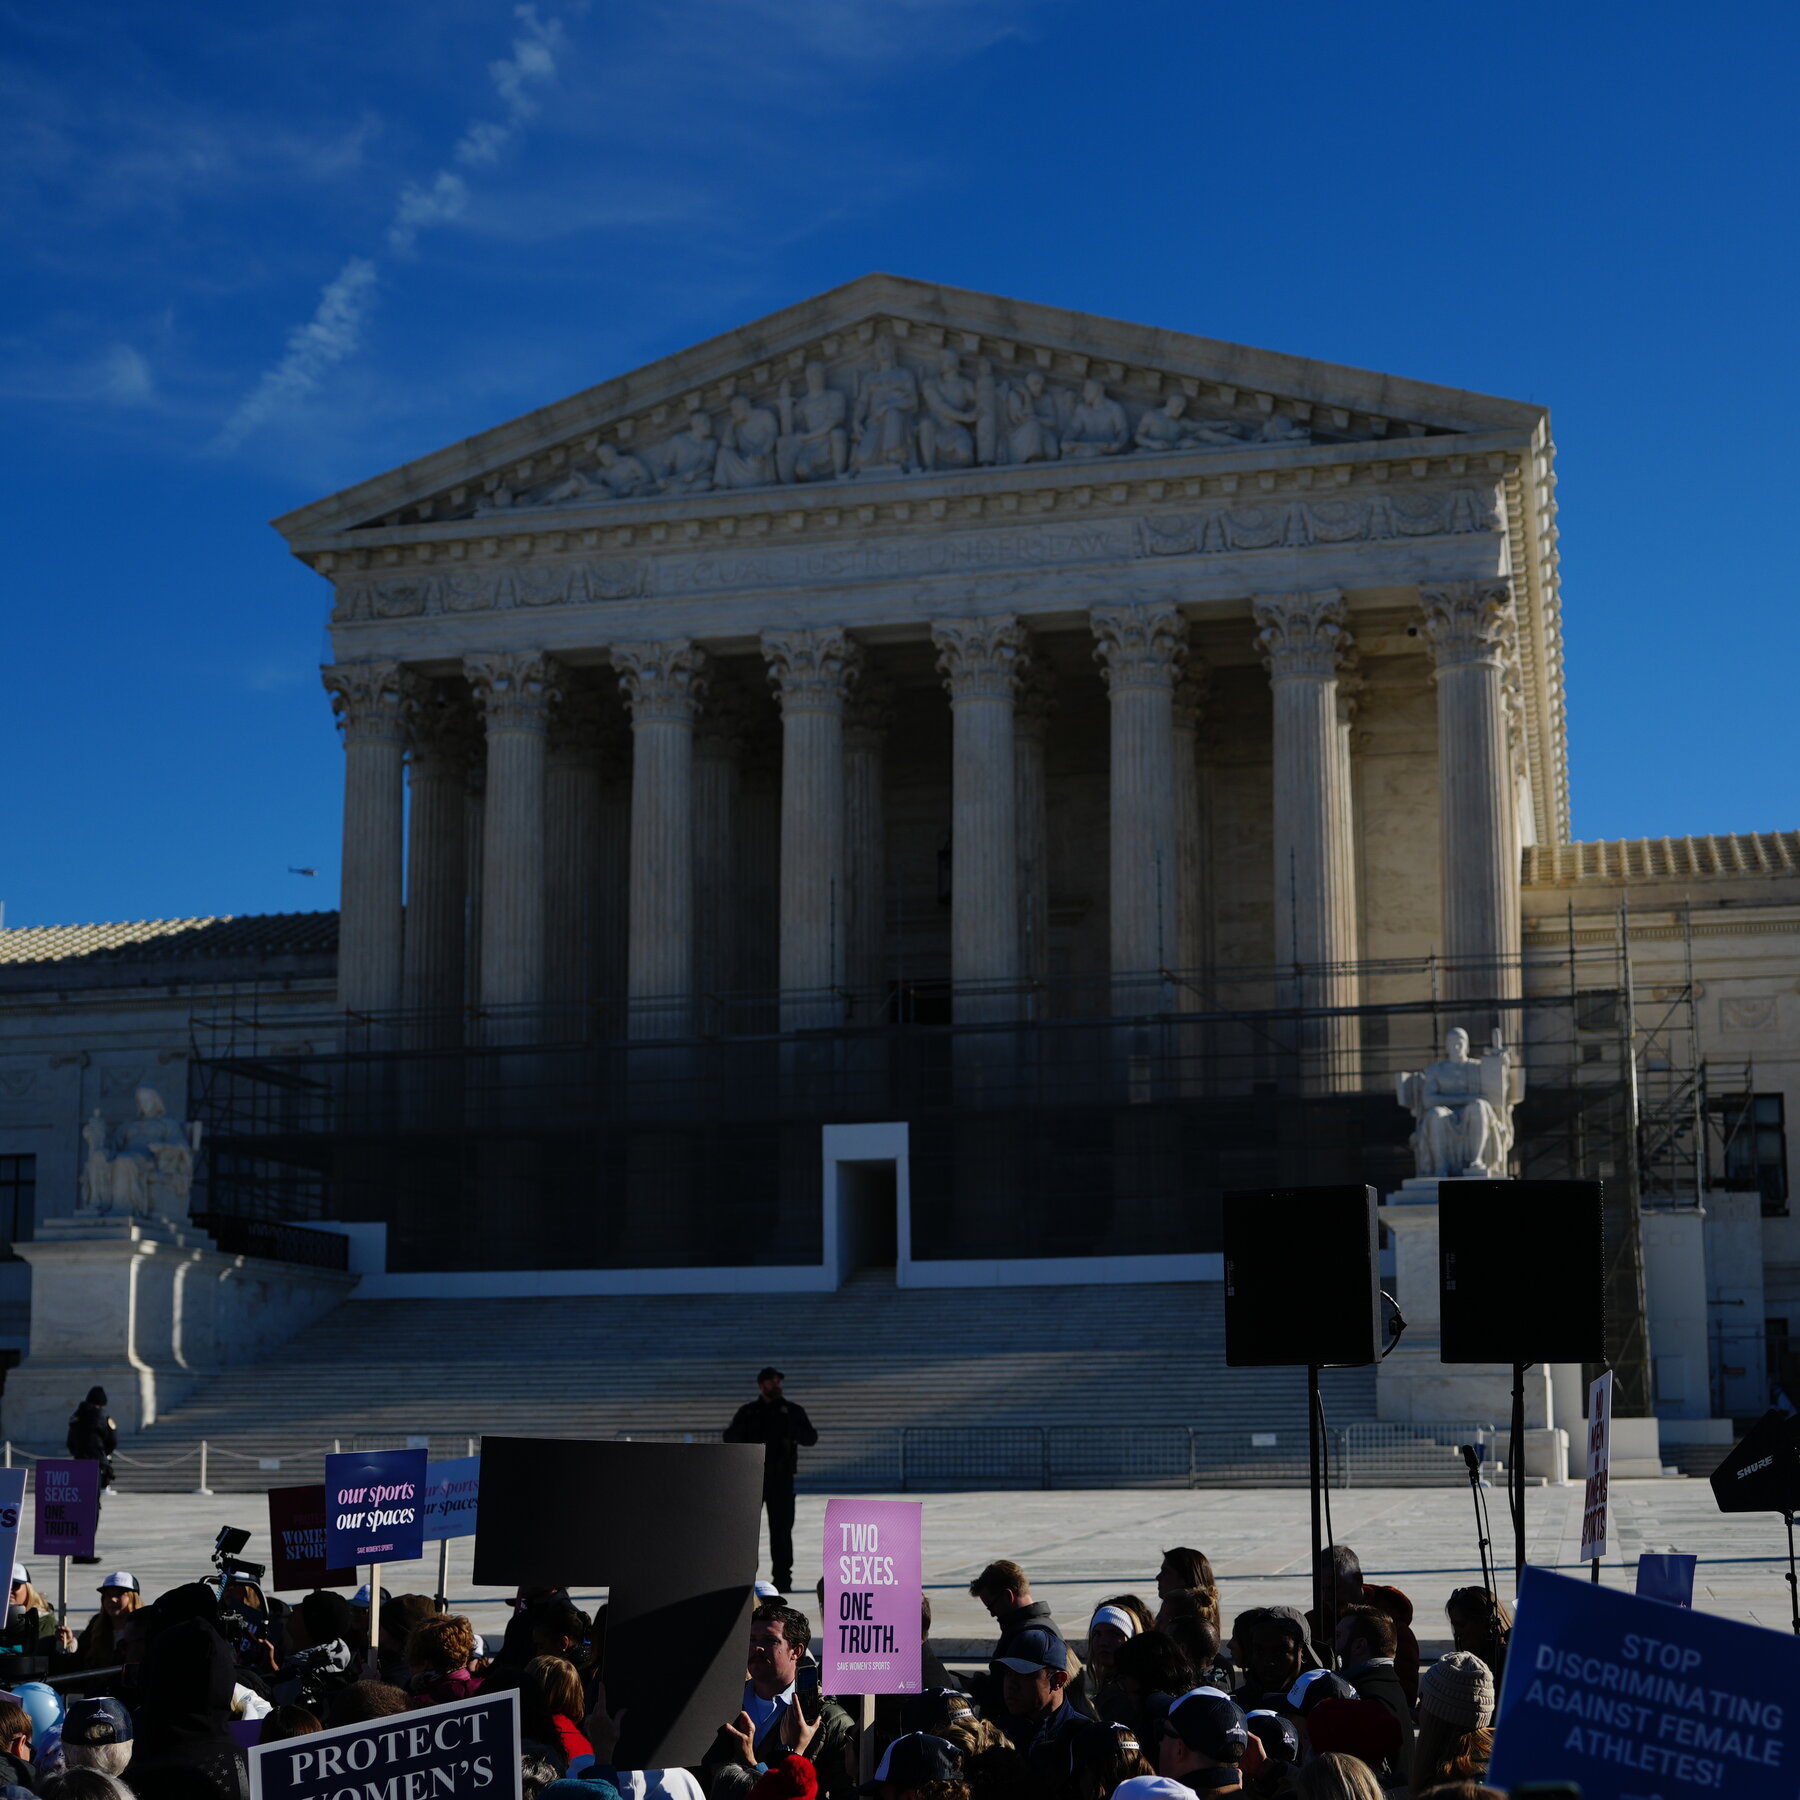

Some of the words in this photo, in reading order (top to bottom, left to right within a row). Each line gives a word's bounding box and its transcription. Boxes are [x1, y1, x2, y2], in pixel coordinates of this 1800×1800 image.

[1595, 1388, 1604, 1421] NO
[1591, 1420, 1604, 1454] MEN
[44, 1471, 70, 1486] TWO
[1736, 1455, 1774, 1480] SHURE
[44, 1487, 82, 1502] SEXES.
[338, 1486, 367, 1505] our
[368, 1481, 415, 1507] sports
[424, 1485, 438, 1496] ur
[44, 1505, 65, 1520] ONE
[336, 1512, 366, 1530] our
[367, 1507, 415, 1532] spaces
[423, 1503, 437, 1514] ur
[44, 1522, 82, 1537] TRUTH.
[281, 1528, 327, 1544] WOME
[839, 1523, 879, 1553] TWO
[286, 1544, 327, 1560] SPOR
[839, 1555, 899, 1586] SEXES.
[840, 1592, 874, 1621] ONE
[839, 1625, 900, 1654] TRUTH.
[836, 1661, 849, 1671] SAVE
[849, 1661, 872, 1671] WOMEN'S
[872, 1661, 891, 1671] SPORTS
[1621, 1633, 1702, 1674] STOP
[1535, 1644, 1784, 1732] DISCRIMINATING
[1525, 1678, 1653, 1733] AGAINST
[1658, 1712, 1784, 1767] FEMALE
[288, 1711, 489, 1786] PROTECT
[1564, 1725, 1725, 1789] ATHLETES!
